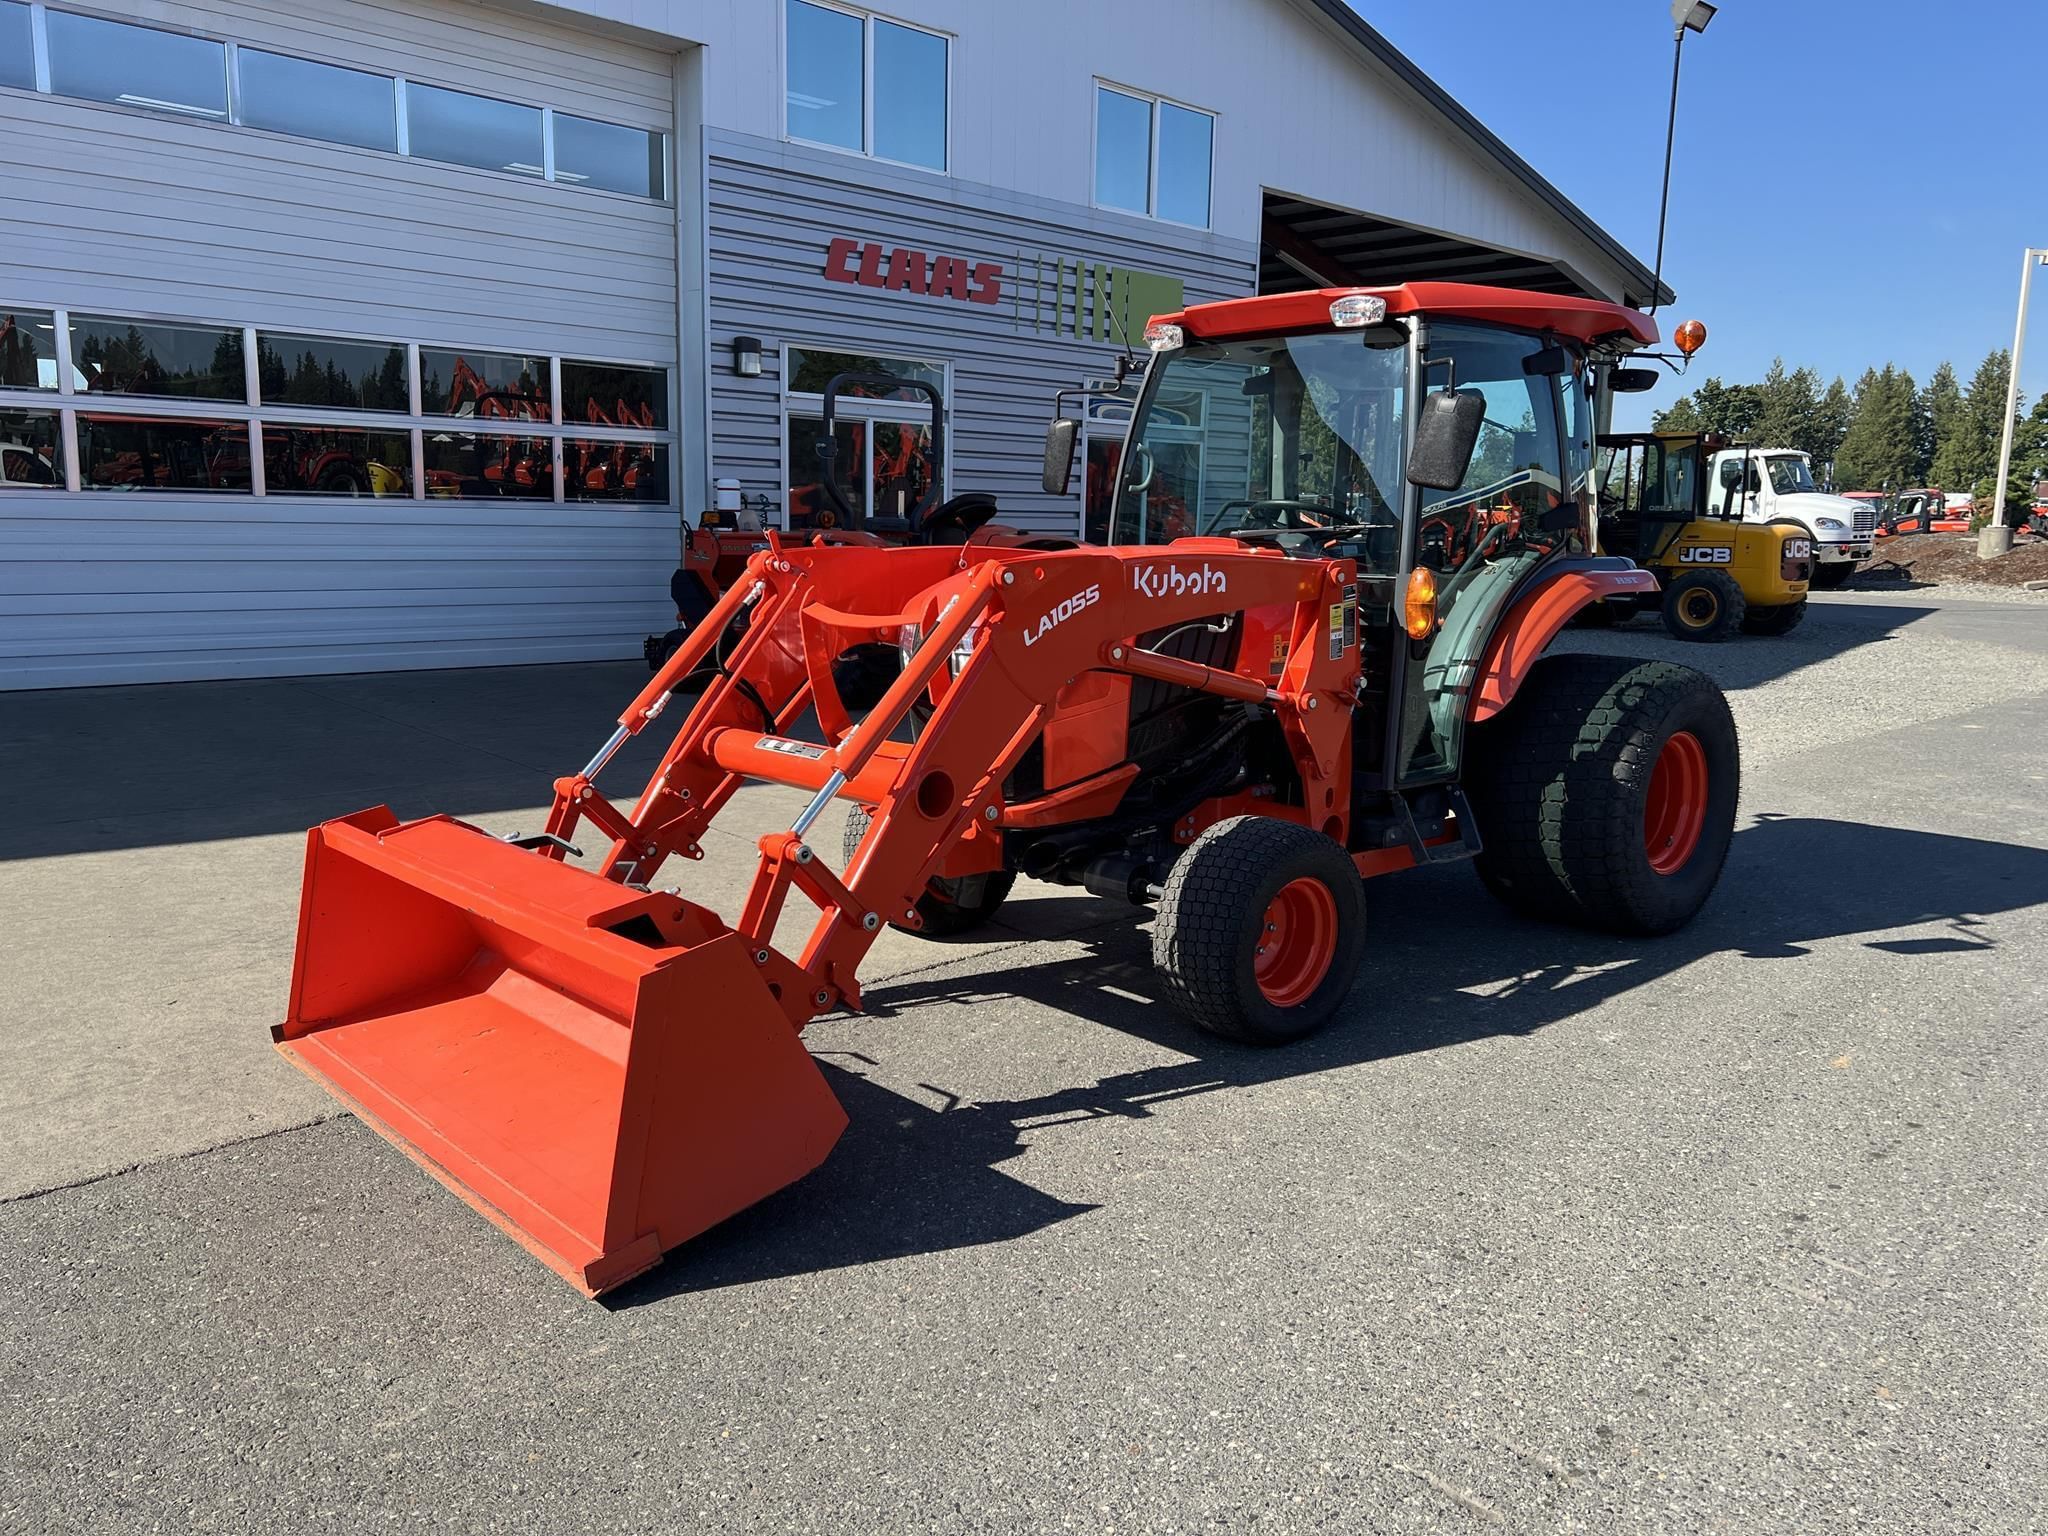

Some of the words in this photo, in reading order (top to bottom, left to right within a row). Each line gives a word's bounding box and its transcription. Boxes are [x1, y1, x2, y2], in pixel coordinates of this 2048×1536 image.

[824, 238, 1003, 305] CLAAS
[1680, 547, 1731, 562] JCB
[1785, 540, 1810, 558] JCB
[1134, 563, 1226, 597] Kubota
[1023, 584, 1100, 647] LA1055
